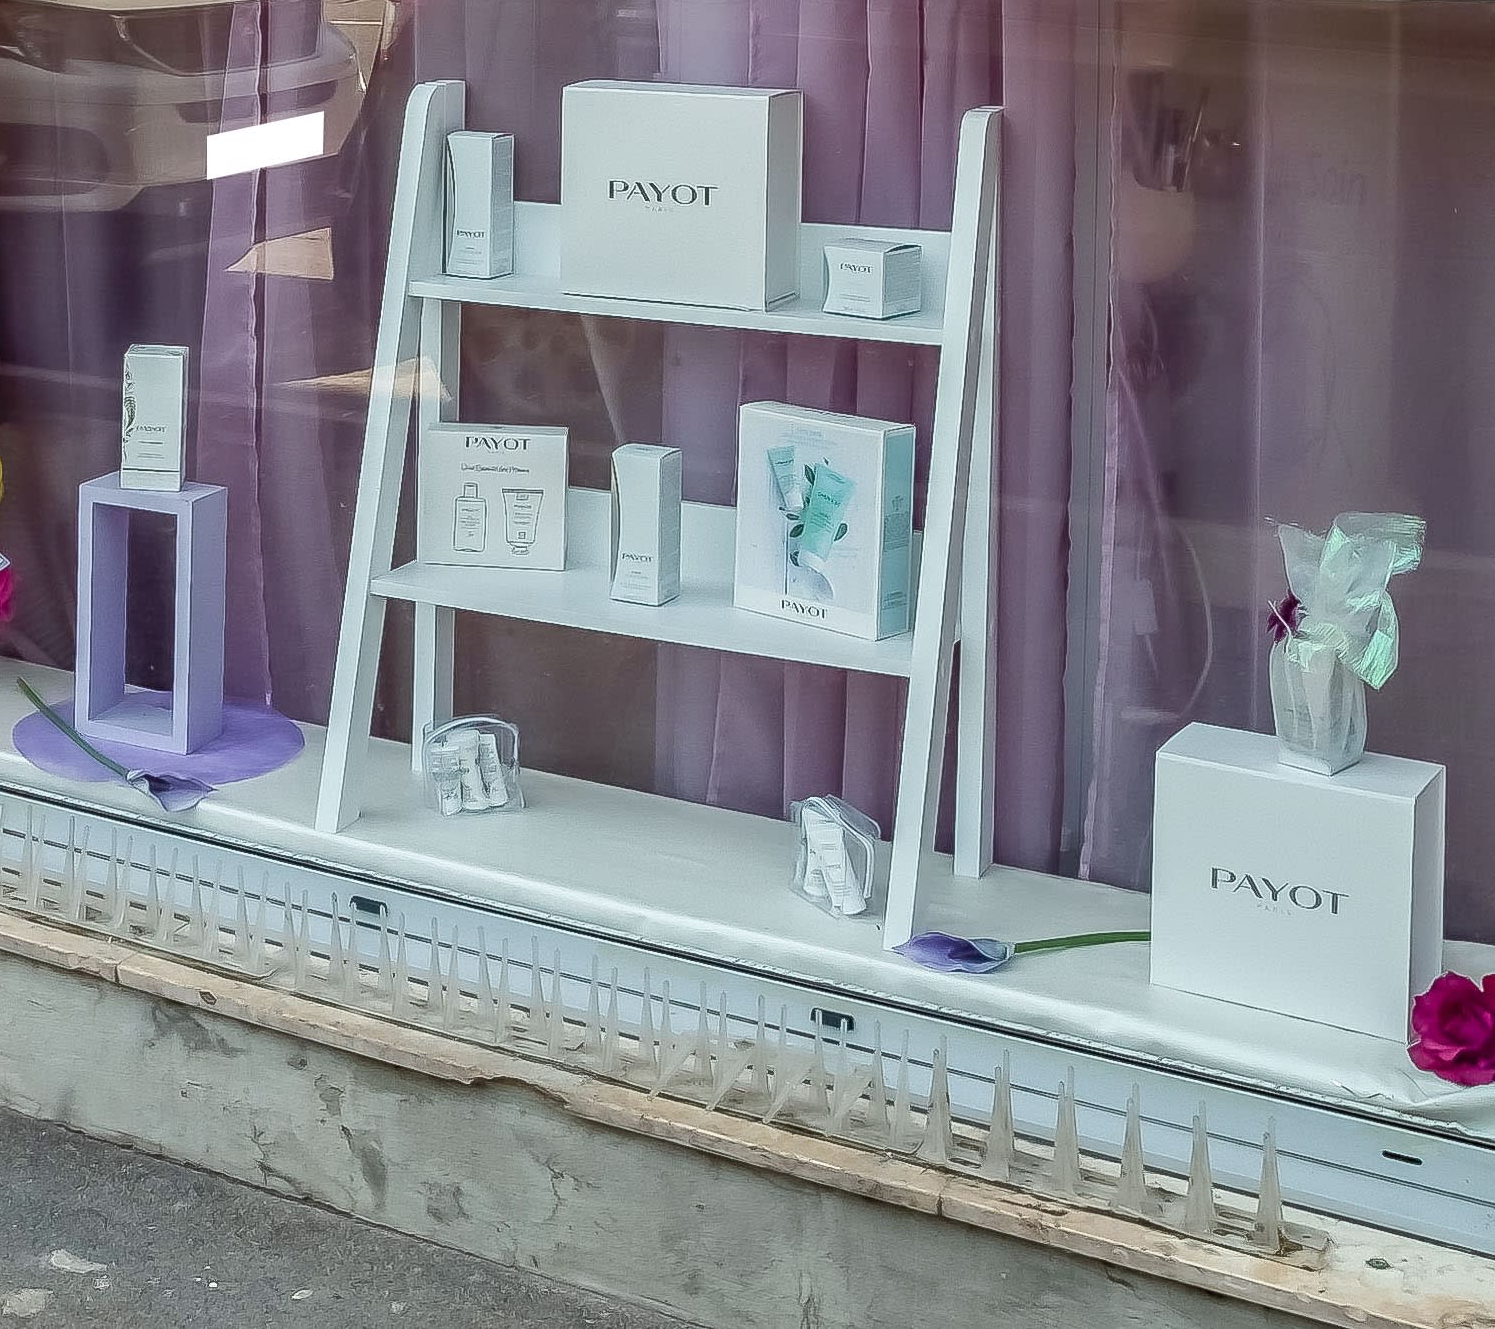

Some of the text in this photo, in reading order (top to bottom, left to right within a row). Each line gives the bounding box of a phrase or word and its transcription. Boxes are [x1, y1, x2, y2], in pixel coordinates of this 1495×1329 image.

[609, 180, 720, 206] PAYOT
[465, 436, 532, 450] PAYOT
[780, 598, 829, 619] PAYOT
[1210, 866, 1350, 916] PAYOT
